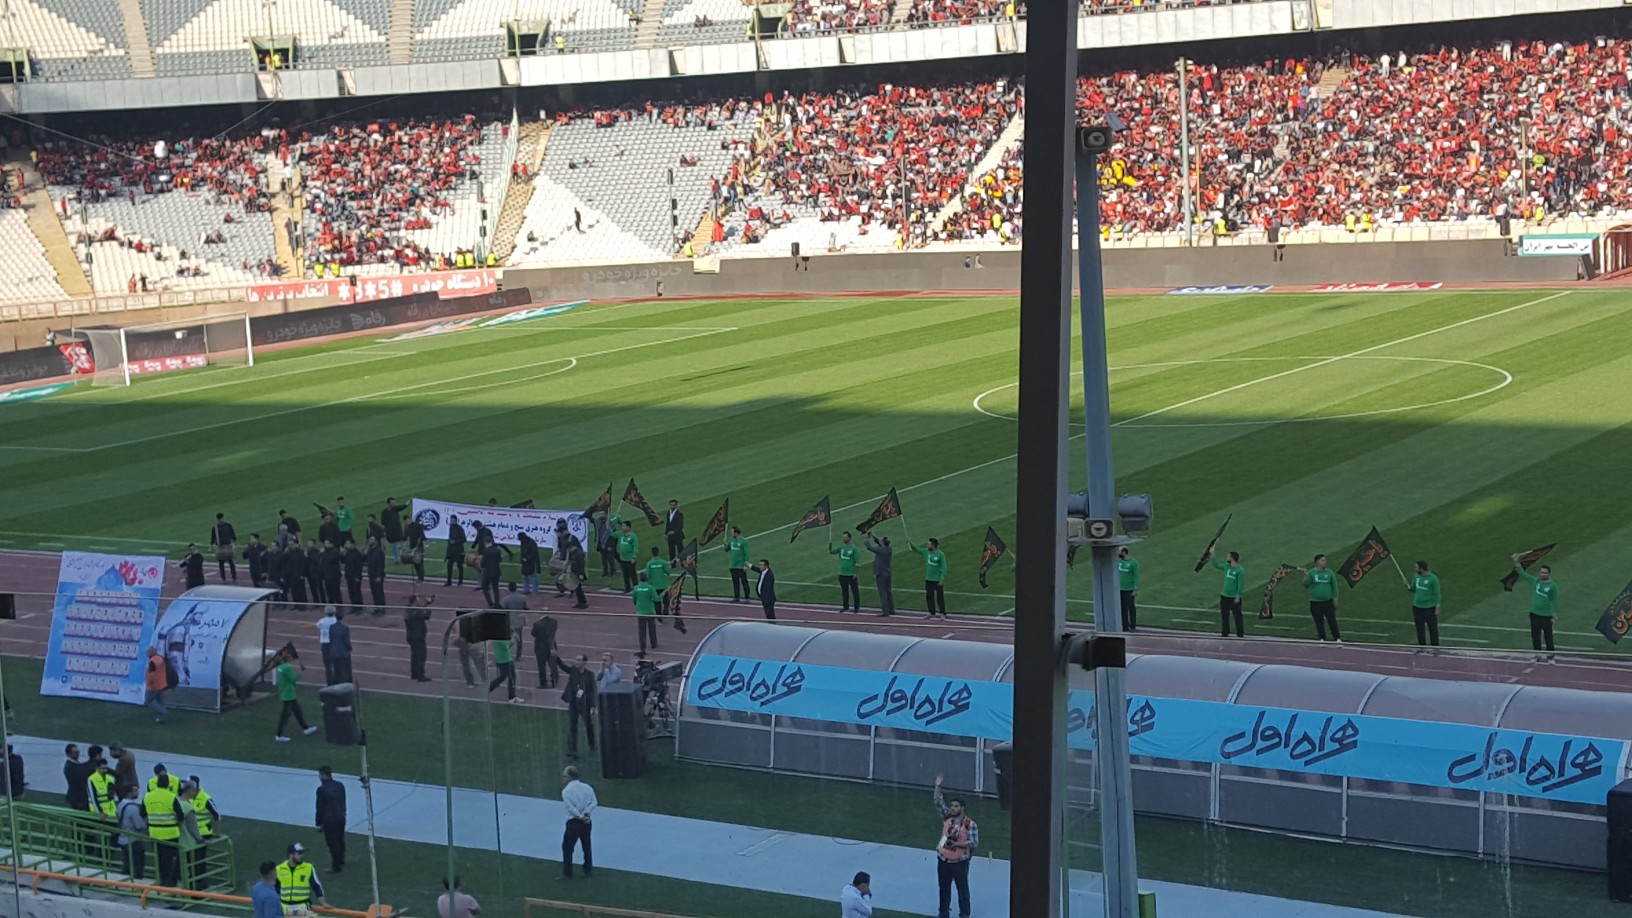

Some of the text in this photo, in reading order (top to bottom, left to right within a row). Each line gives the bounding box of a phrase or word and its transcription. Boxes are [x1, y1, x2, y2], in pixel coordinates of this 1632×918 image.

[446, 273, 481, 290] دستگاه
[582, 268, 623, 283] خودرو
[247, 287, 260, 303] ها
[295, 281, 329, 299] انتخاب
[412, 278, 444, 294] خودرو
[365, 308, 386, 327] رفاه
[539, 525, 552, 535] گروه
[697, 658, 806, 708] همراه اول
[856, 675, 973, 727] همراه اول
[1219, 709, 1360, 767] همراه اول
[1447, 731, 1604, 794] همراه اول
